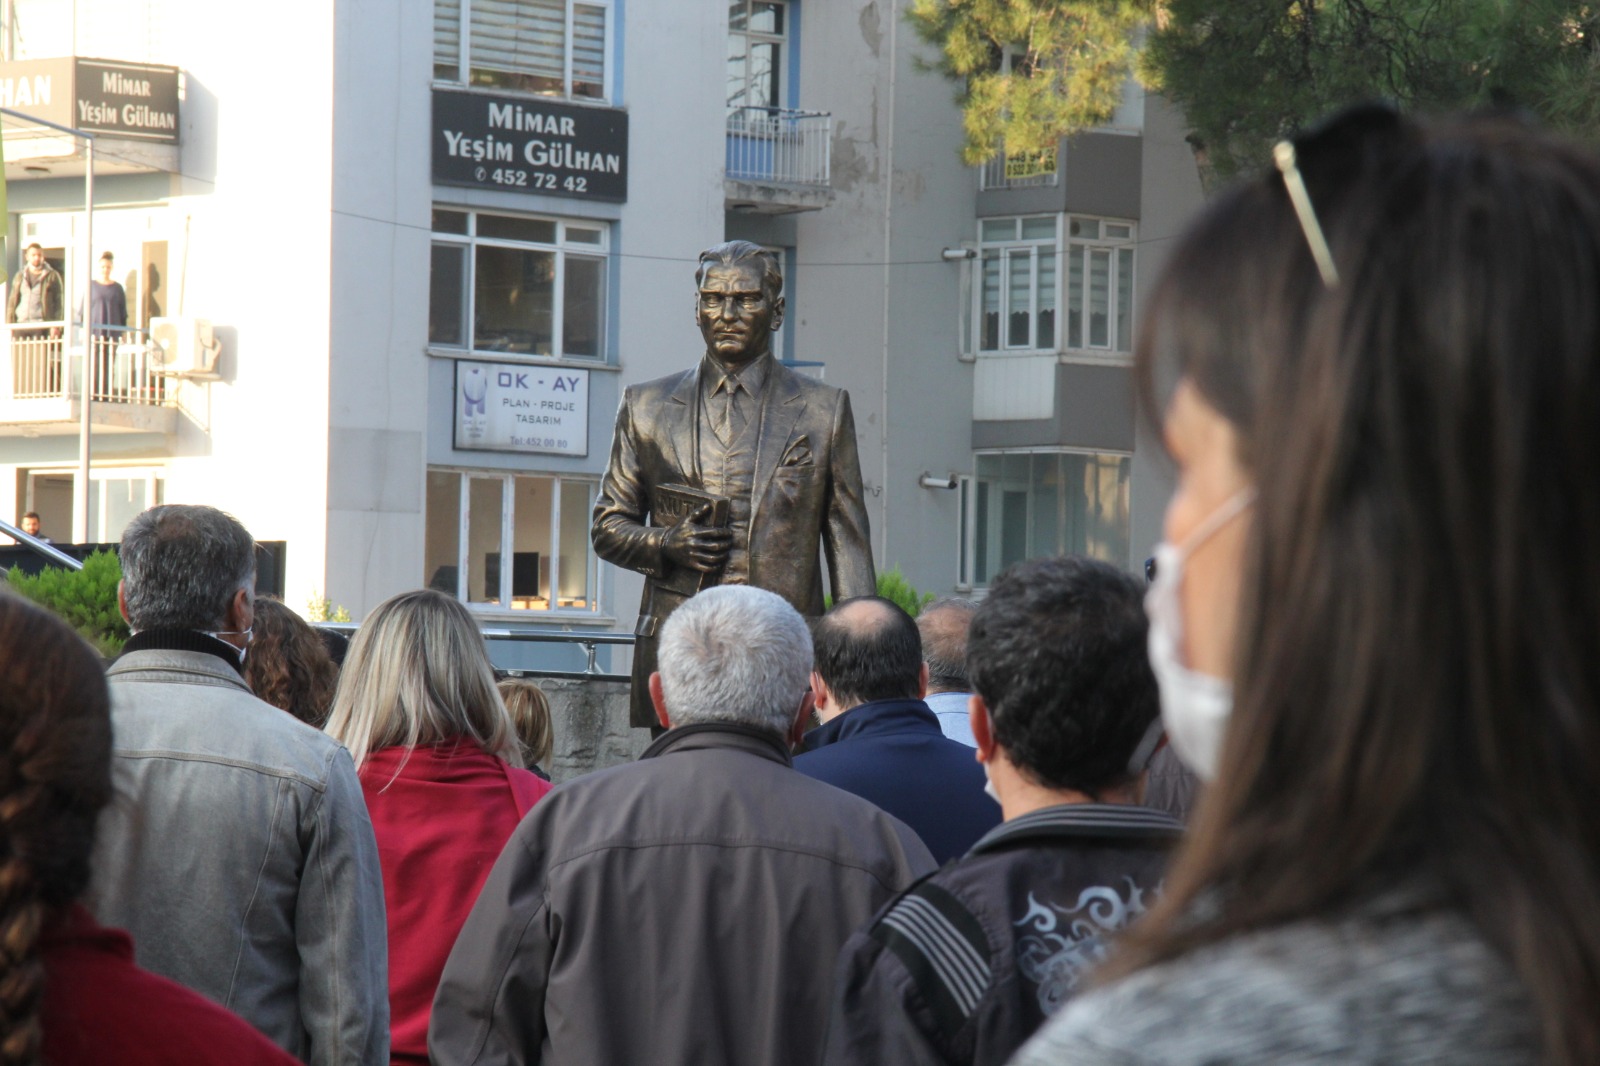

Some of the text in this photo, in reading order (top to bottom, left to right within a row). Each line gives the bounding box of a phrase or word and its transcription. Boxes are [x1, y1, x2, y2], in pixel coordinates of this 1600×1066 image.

[491, 168, 587, 193] 452 72 42
[498, 372, 529, 390] OK
[552, 376, 580, 393] AY
[502, 398, 530, 408] PLAN
[540, 400, 575, 412] PROJE
[515, 414, 561, 425] TASARIM
